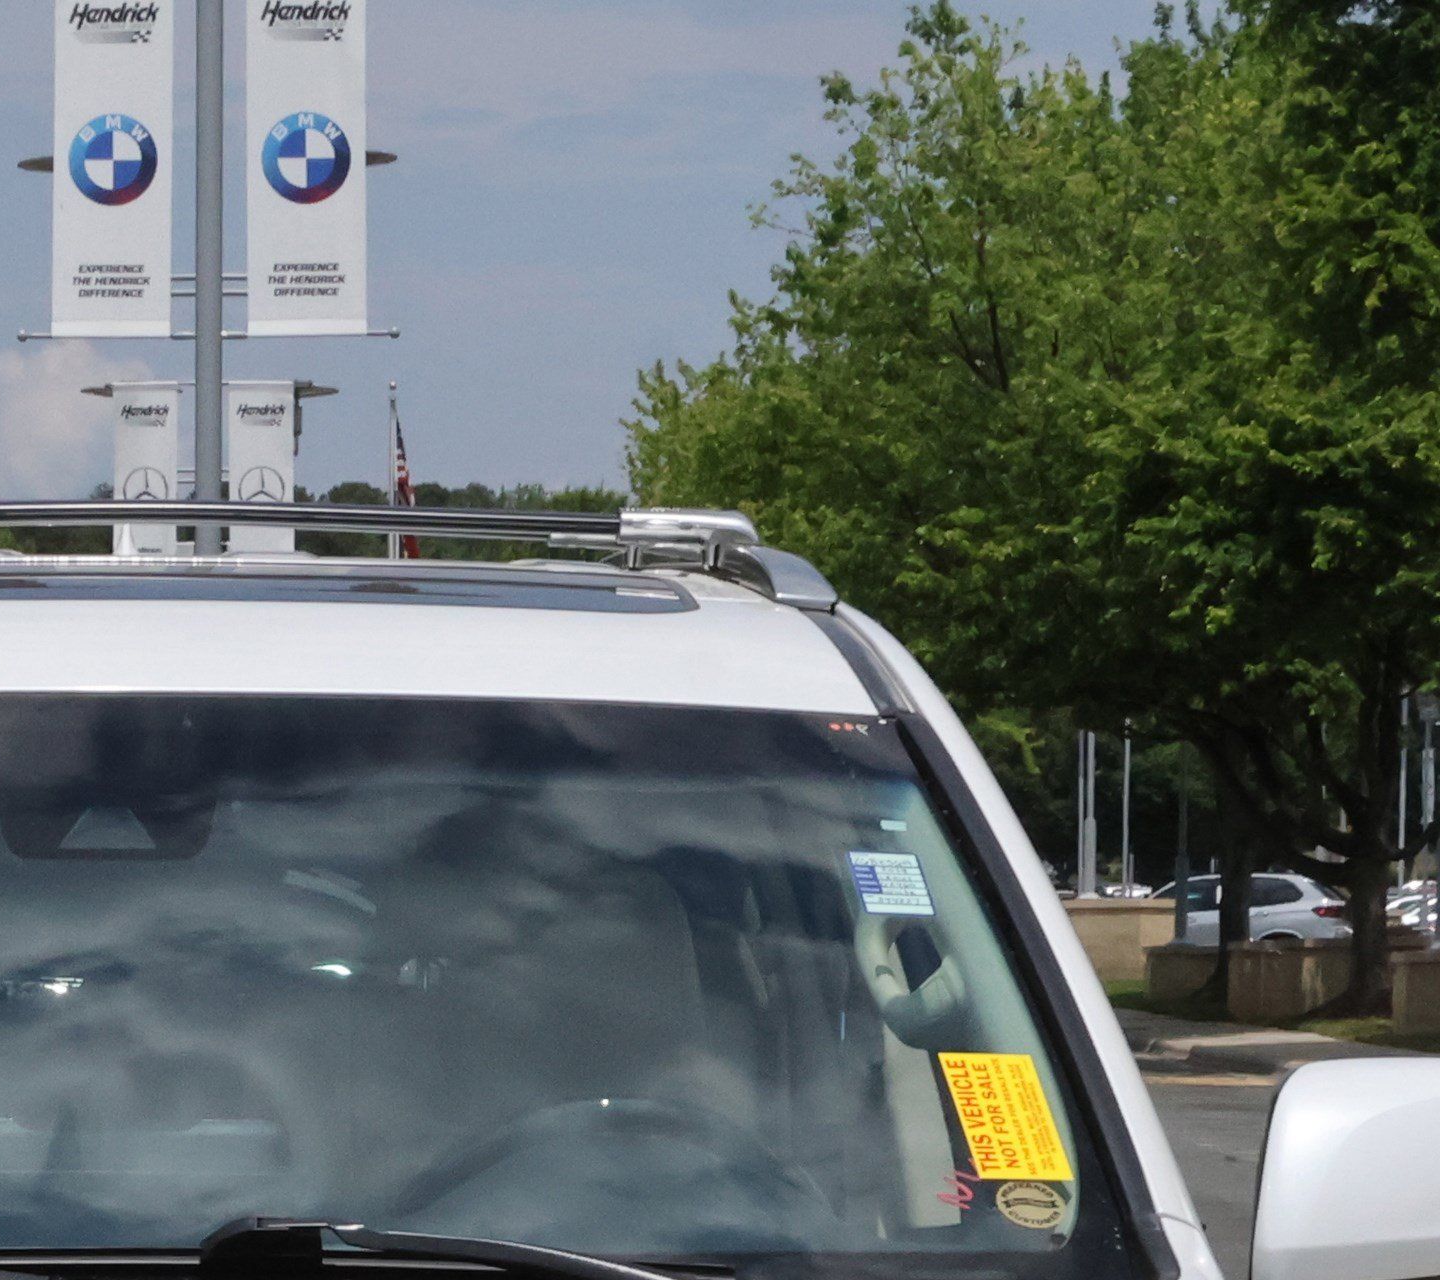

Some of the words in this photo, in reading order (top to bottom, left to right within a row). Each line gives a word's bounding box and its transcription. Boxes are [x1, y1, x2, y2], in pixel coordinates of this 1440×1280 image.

[70, 1, 160, 30] Hendrick
[261, 0, 351, 27] Hendrick
[78, 113, 149, 143] BMW
[271, 112, 341, 141] BMW
[78, 264, 145, 274] EXPERIENCE
[267, 275, 289, 285] THE
[289, 275, 346, 284] HENDRICK
[273, 262, 340, 272] EXPERIENCE
[72, 276, 93, 286] THE
[94, 277, 151, 286] HENDRICK
[78, 288, 144, 298] DIFFERENCE
[273, 286, 340, 297] DIFFERENCE
[121, 403, 170, 420] Hendrick
[236, 403, 286, 420] Hendrick
[946, 1060, 986, 1129] VEHICLE
[972, 1063, 997, 1100] SALE
[987, 1104, 1009, 1134] FOR
[972, 1134, 1001, 1172] THIS
[998, 1139, 1021, 1169] NOT
